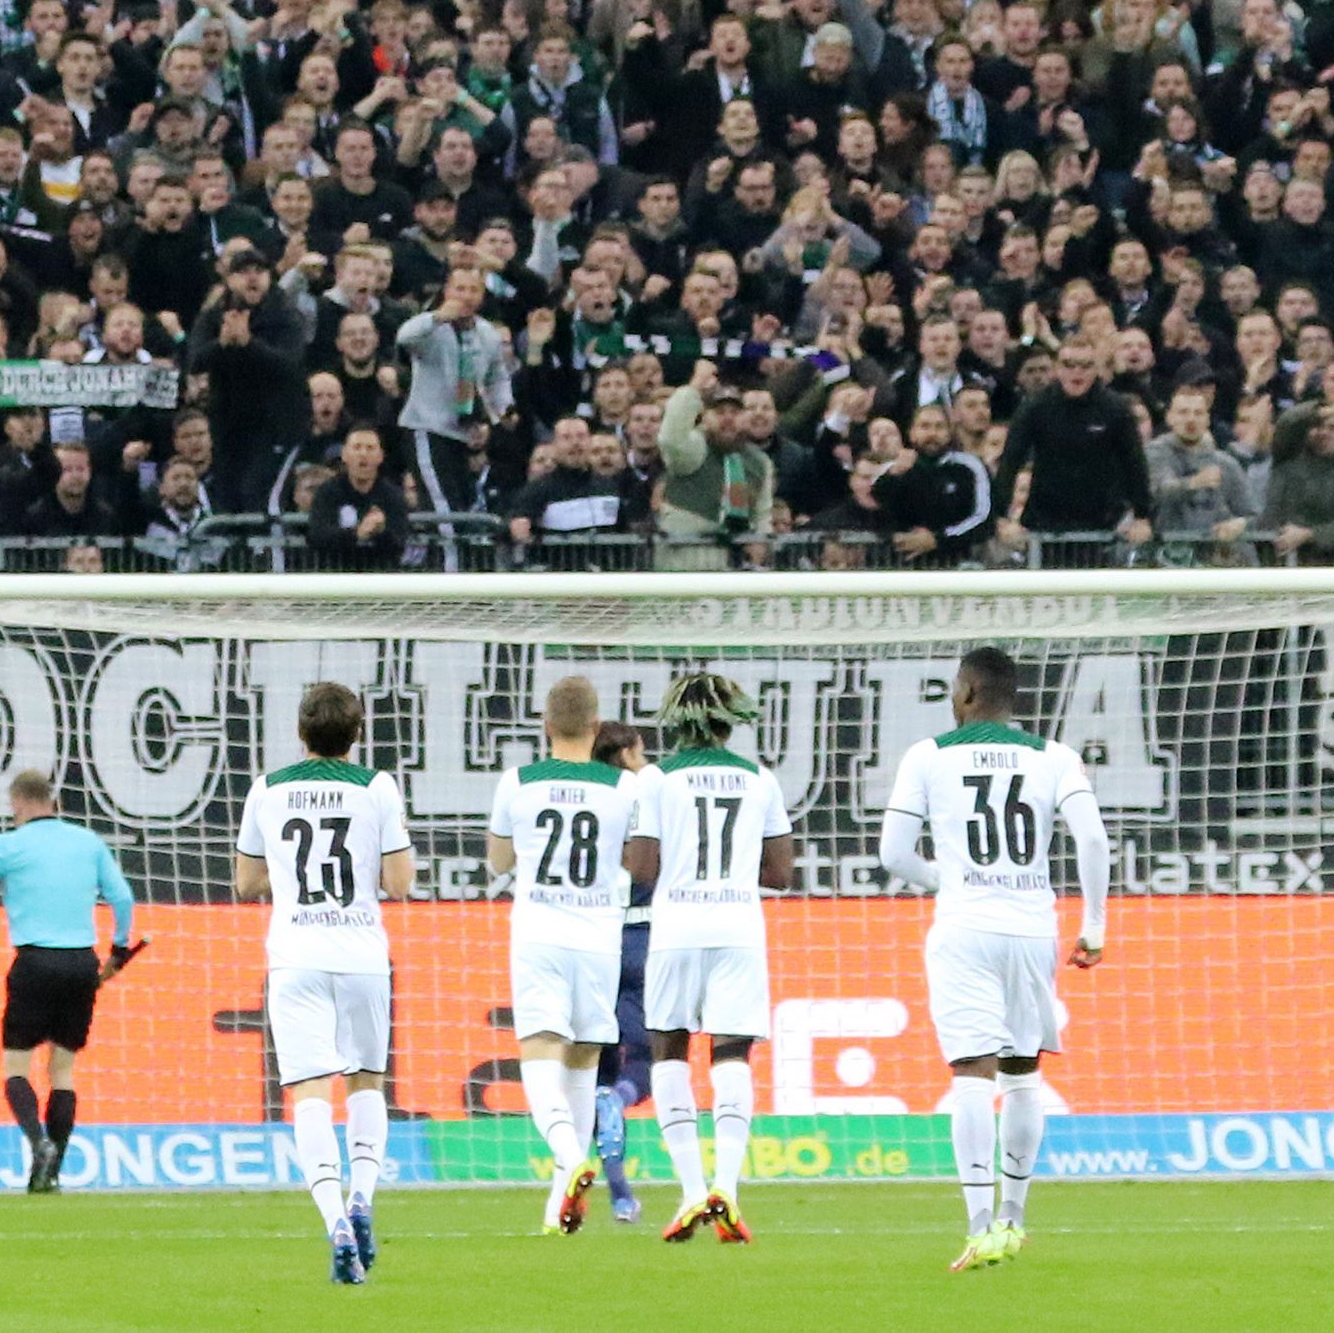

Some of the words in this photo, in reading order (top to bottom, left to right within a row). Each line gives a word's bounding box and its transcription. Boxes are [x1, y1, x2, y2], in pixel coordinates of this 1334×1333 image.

[973, 751, 1018, 769] EMBOLO
[288, 791, 343, 810] HOFMANN
[549, 787, 586, 804] GINTER
[963, 774, 1036, 866] 36
[281, 817, 355, 908] 23
[535, 808, 599, 888] 28
[694, 796, 743, 881] 17
[1049, 1150, 1158, 1174] www.
